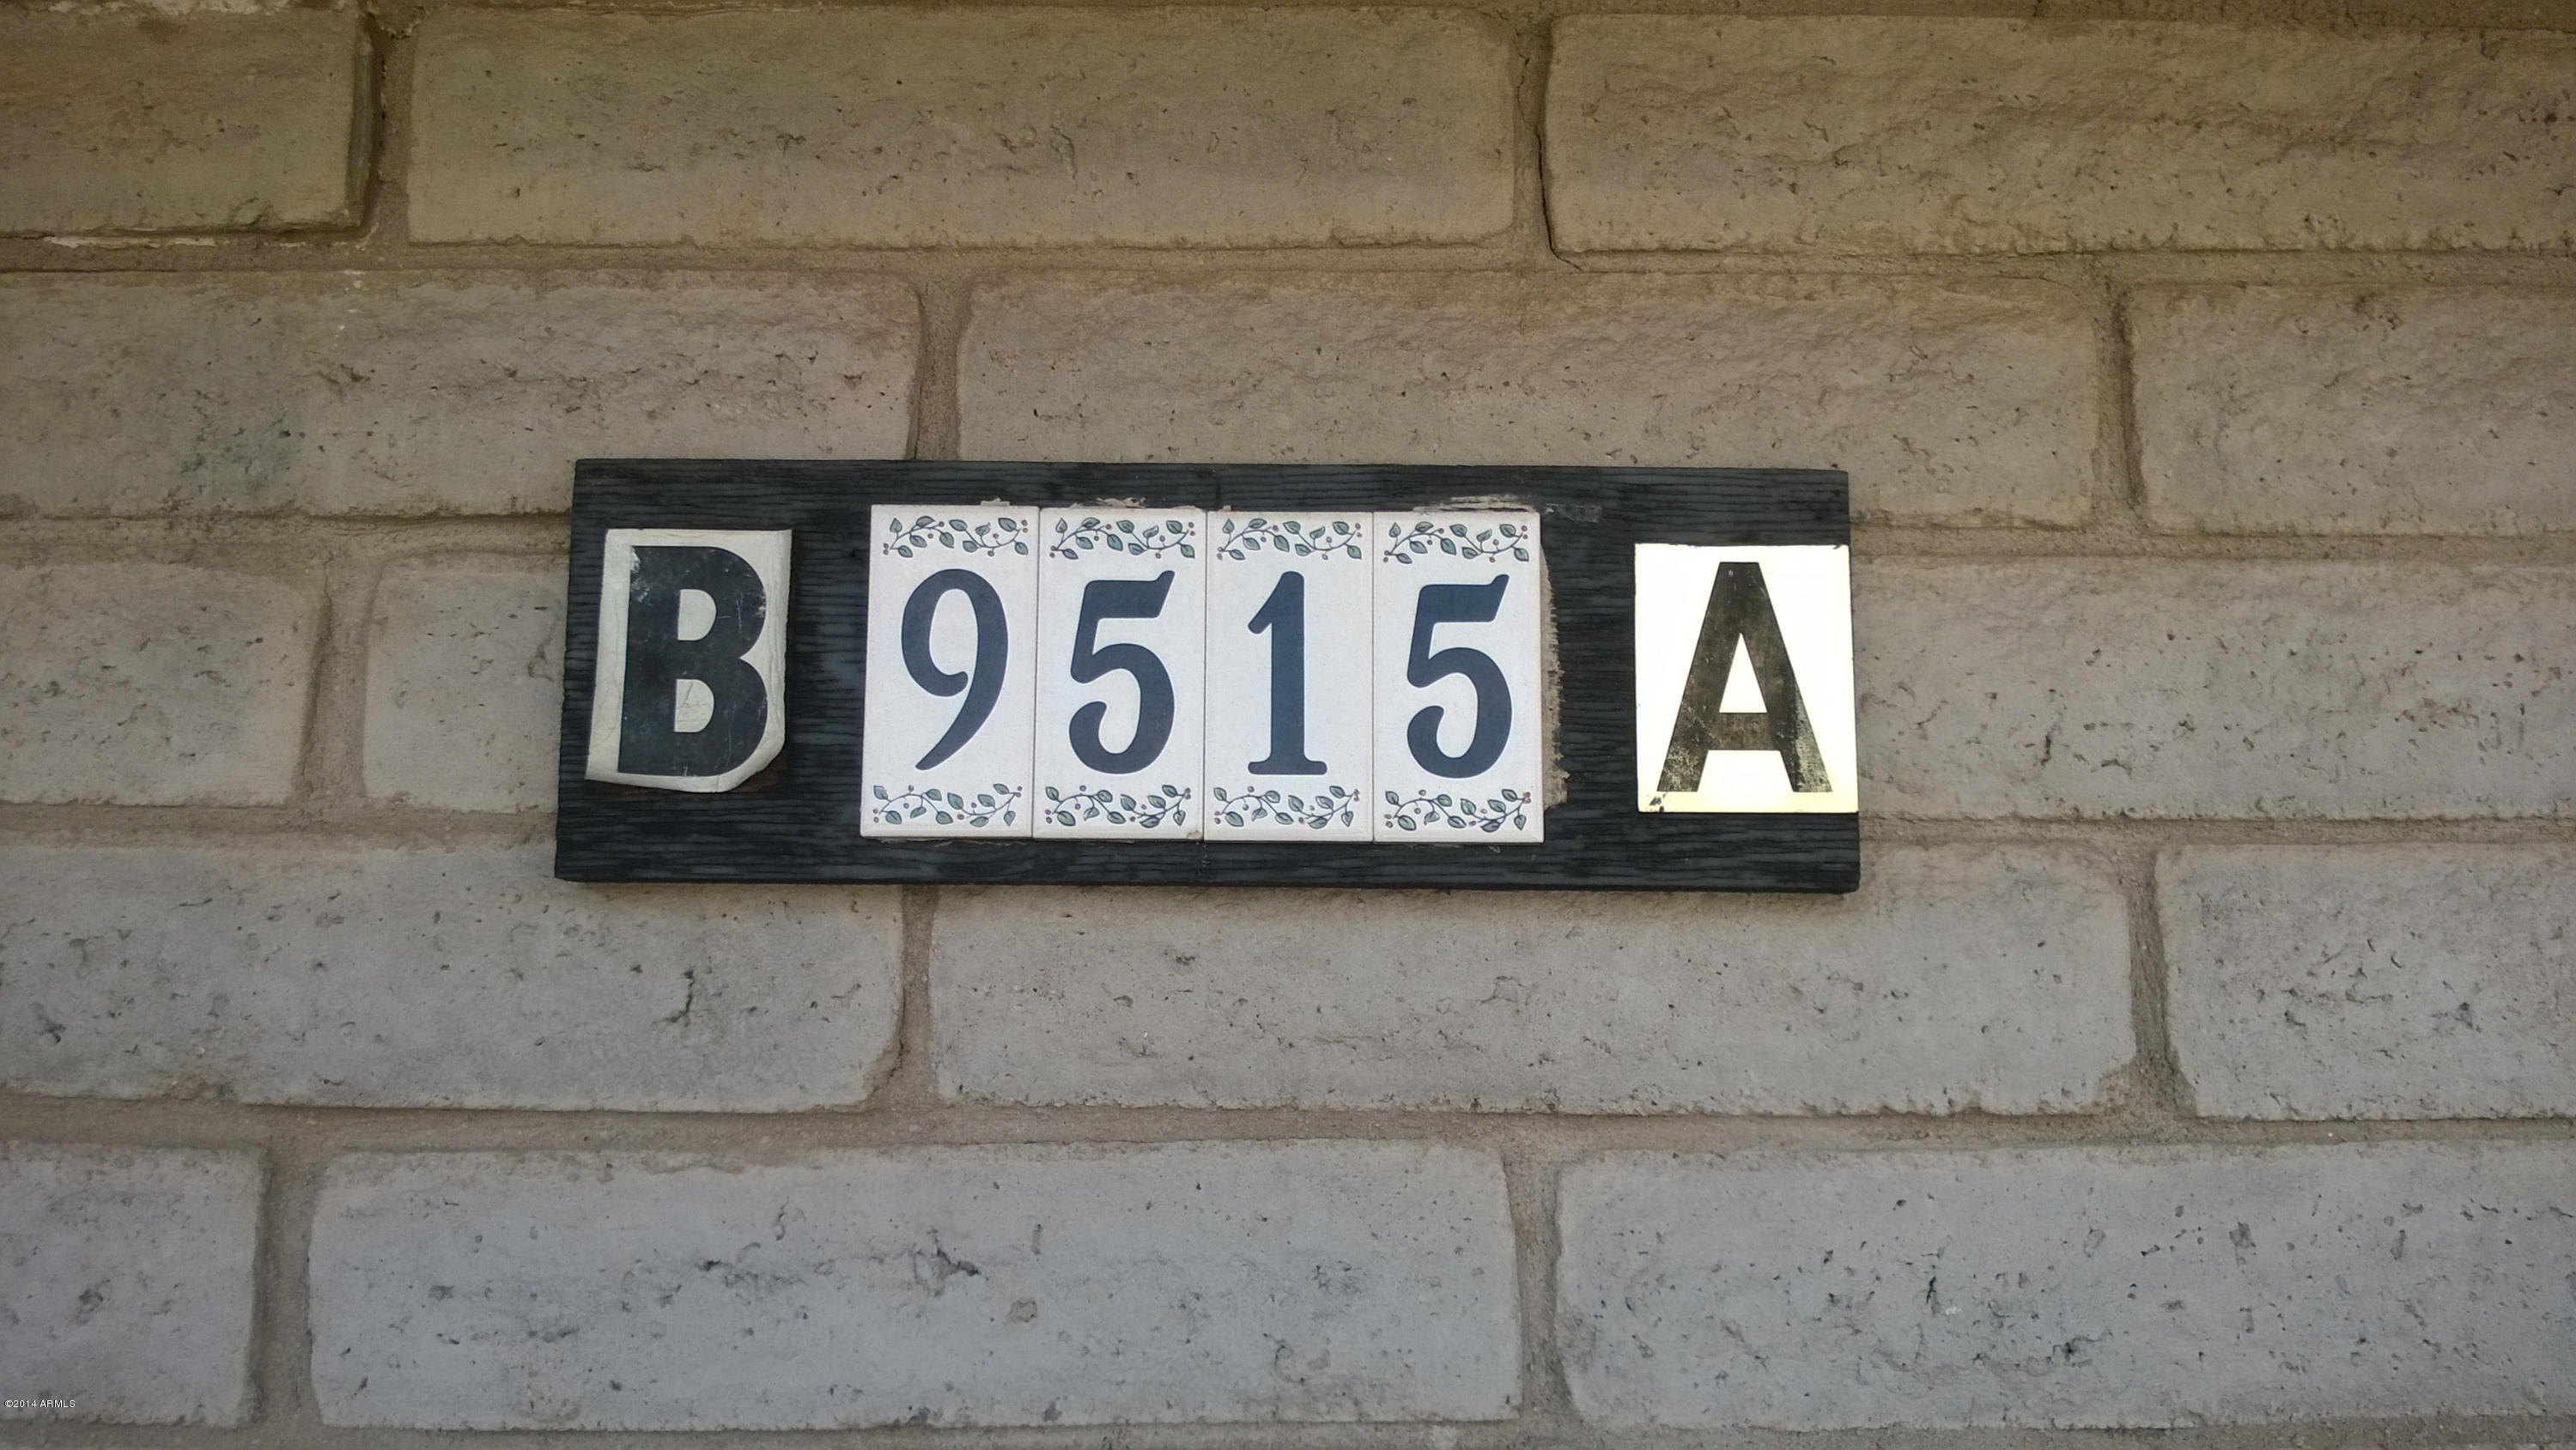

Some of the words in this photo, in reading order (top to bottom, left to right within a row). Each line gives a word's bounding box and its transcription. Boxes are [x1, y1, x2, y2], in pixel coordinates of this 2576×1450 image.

[617, 545, 768, 777] B
[901, 568, 1513, 779] 9515
[1656, 561, 1833, 792] A
